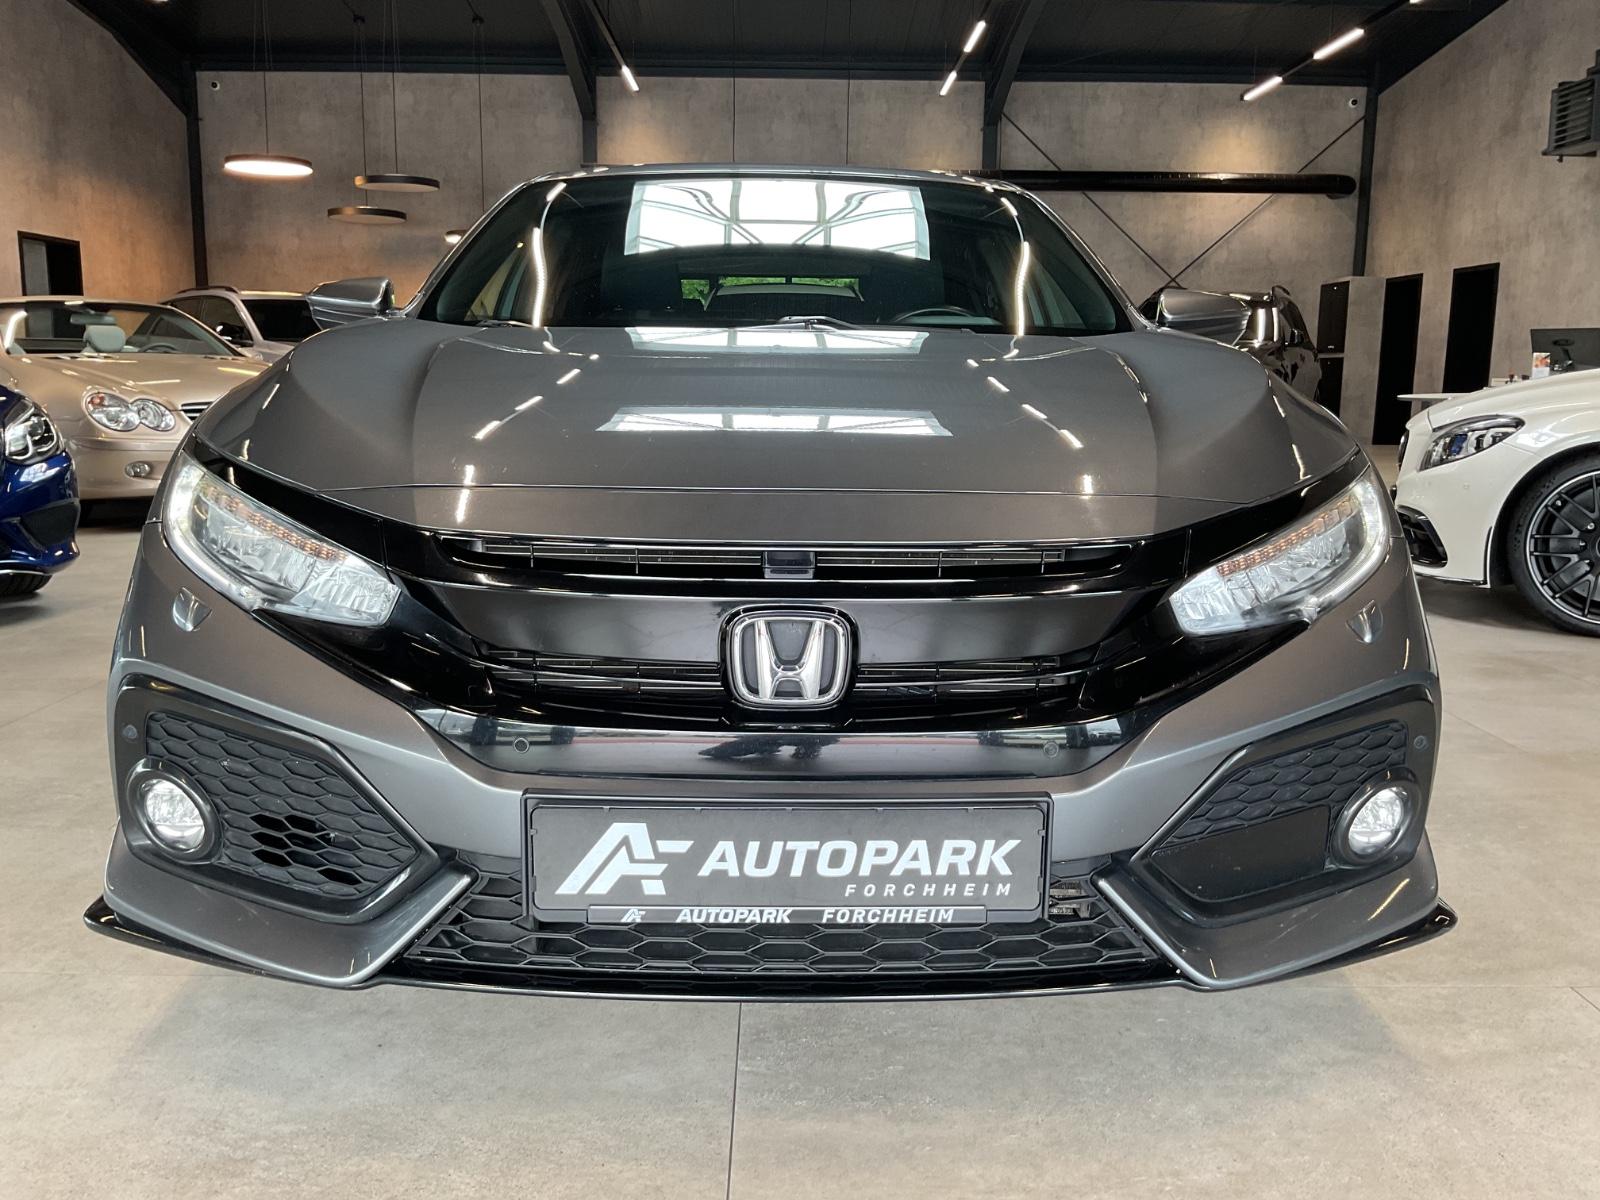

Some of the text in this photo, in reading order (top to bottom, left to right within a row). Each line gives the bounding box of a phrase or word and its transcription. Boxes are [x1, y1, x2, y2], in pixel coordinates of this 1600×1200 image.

[697, 839, 1021, 878] AUTOPARK
[845, 882, 1011, 898] FORCHHEIM
[676, 908, 793, 923] AUTOPARK
[822, 908, 954, 923] FORCHHEIM
